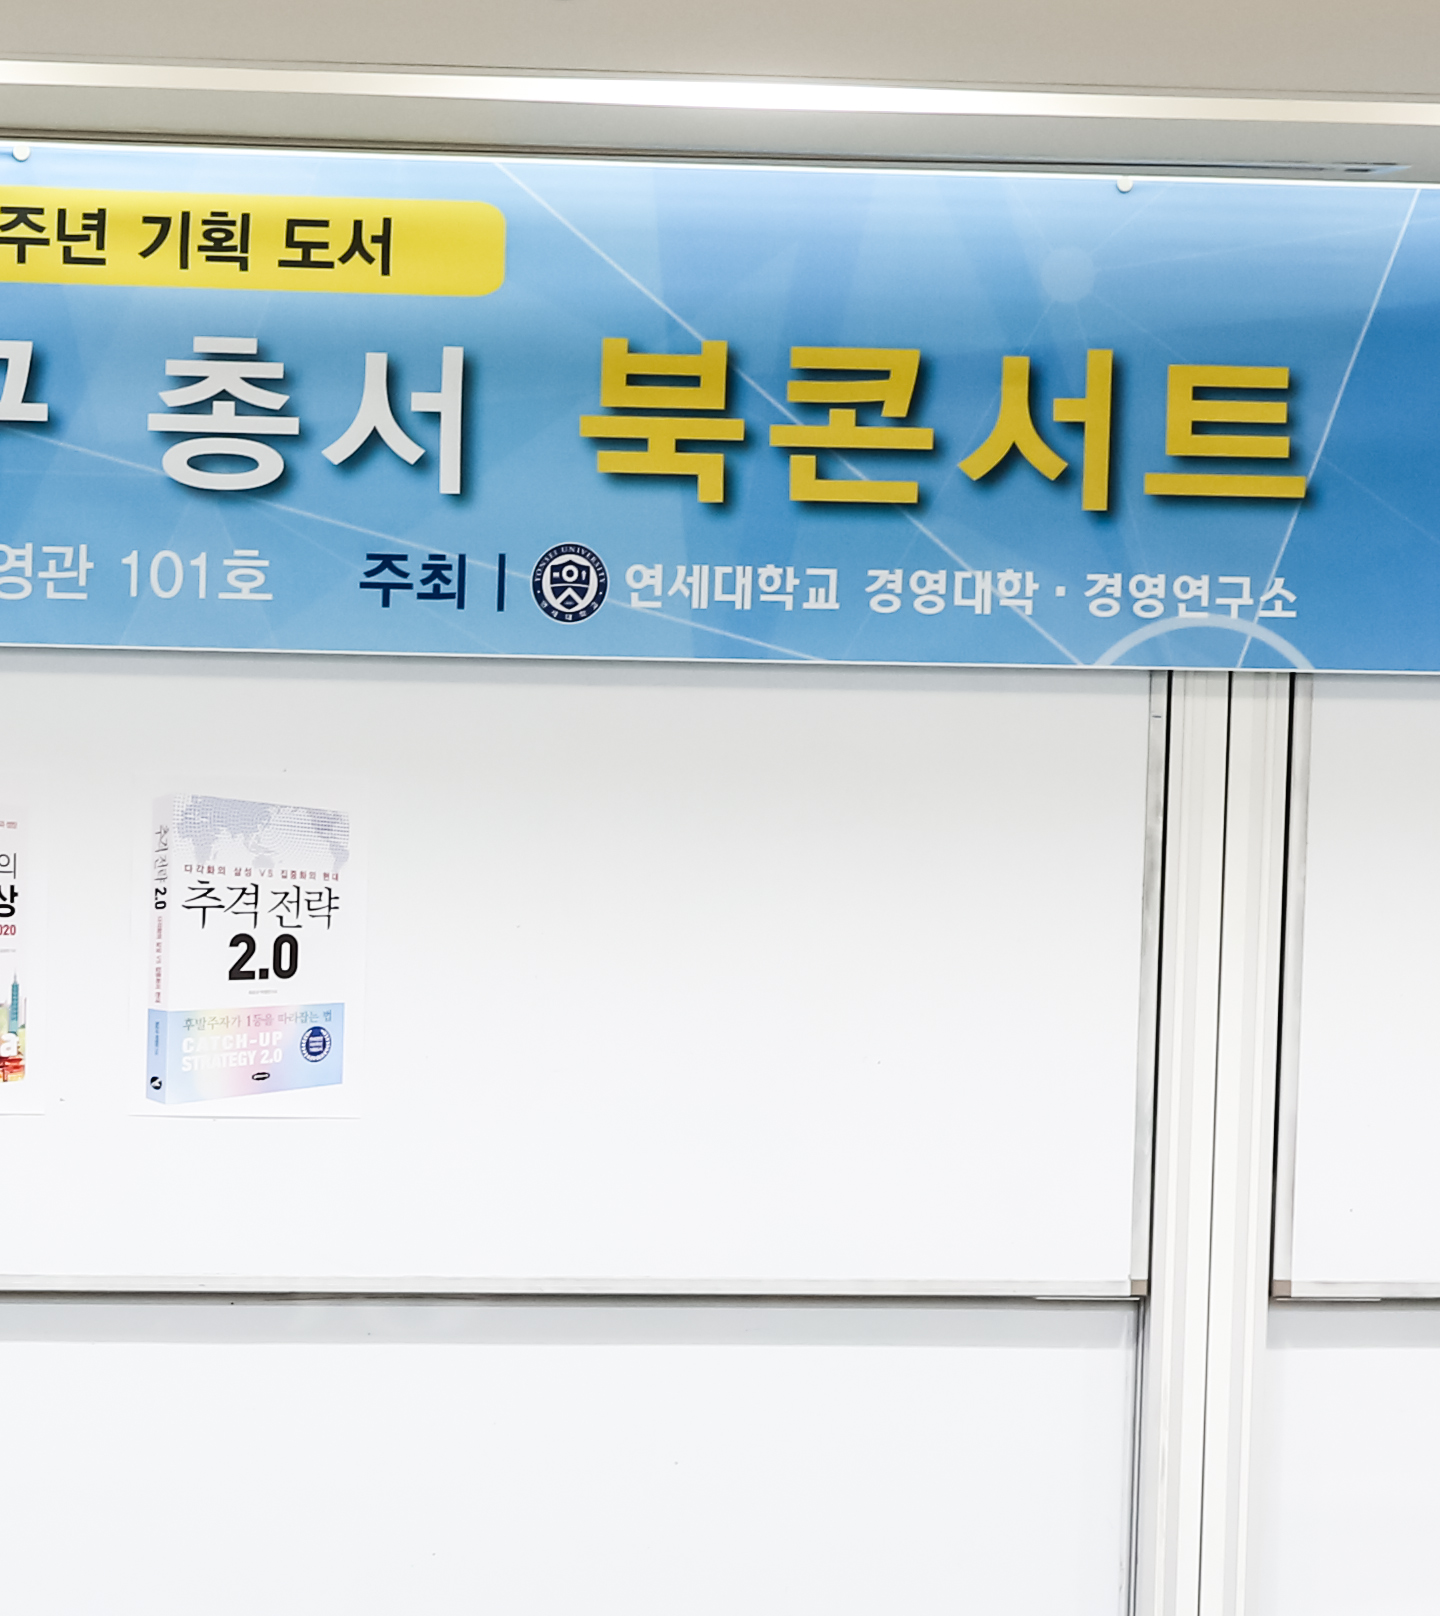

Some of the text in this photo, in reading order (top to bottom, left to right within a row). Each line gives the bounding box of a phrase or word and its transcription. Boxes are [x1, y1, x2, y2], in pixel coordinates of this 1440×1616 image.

[140, 212, 251, 272] 기획
[277, 214, 393, 276] 도서
[147, 334, 467, 495] 총서
[579, 337, 1308, 512] 북콘서트
[121, 546, 273, 602] 101호
[359, 551, 468, 609] 주최
[624, 563, 840, 612] 연세대학교
[181, 880, 340, 930] 추격 전략
[228, 933, 298, 981] 2.0
[182, 1031, 283, 1053] CATCH-UP
[260, 1048, 283, 1064] 2.0
